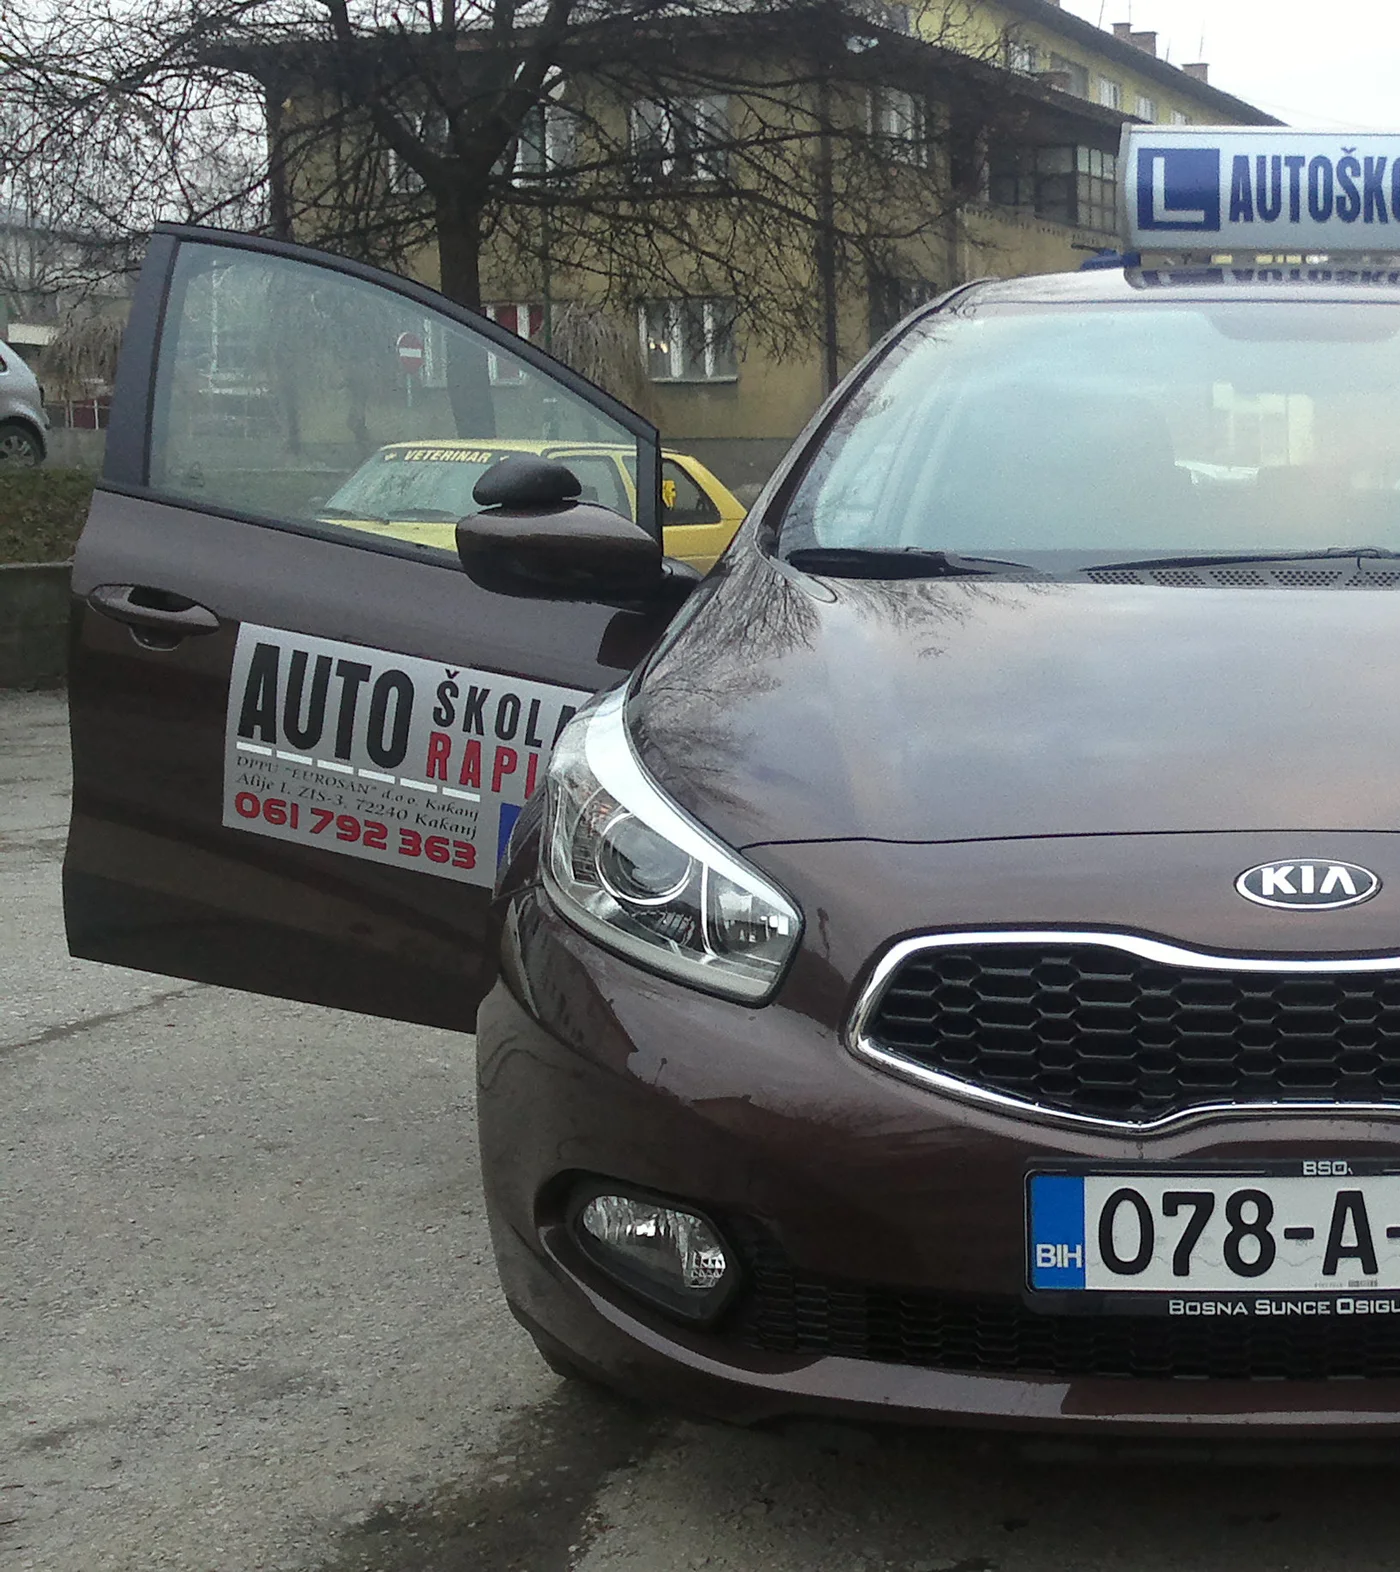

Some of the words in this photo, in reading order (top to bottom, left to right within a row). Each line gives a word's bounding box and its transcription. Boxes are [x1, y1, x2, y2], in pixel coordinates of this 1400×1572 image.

[1152, 156, 1205, 223] L
[403, 449, 493, 463] VETERINAR
[237, 642, 415, 769] AUTO
[426, 730, 539, 800] RAPI
[356, 797, 408, 820] 72240
[415, 812, 477, 841] Kakanj
[425, 798, 479, 822] Kakanj
[234, 791, 299, 831] 061
[309, 807, 388, 850] 792
[399, 827, 477, 870] 363
[1261, 865, 1357, 896] KIA
[1036, 1243, 1083, 1269] BIH
[1168, 1299, 1248, 1316] BOSNA
[1254, 1299, 1331, 1316] SUNCE
